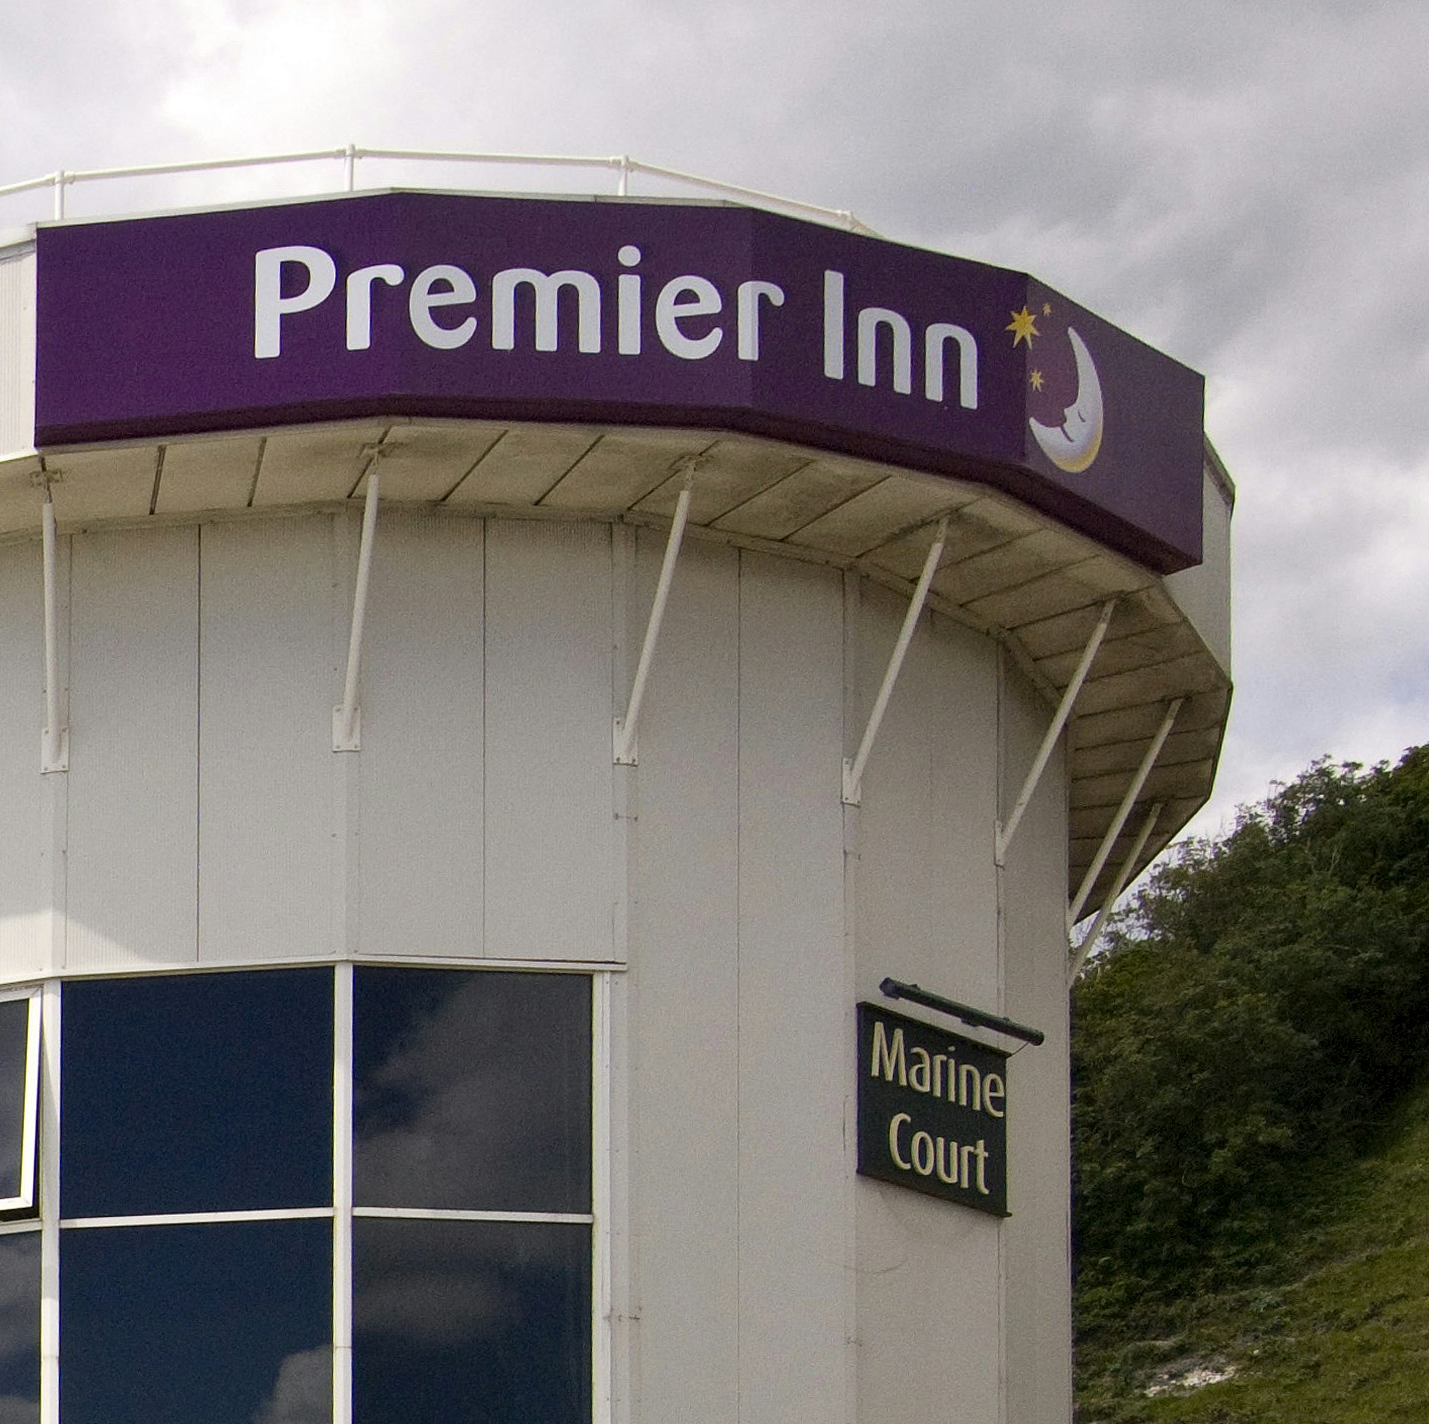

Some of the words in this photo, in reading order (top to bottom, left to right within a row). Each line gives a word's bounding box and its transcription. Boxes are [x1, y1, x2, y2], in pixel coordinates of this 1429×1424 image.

[254, 245, 785, 361] Premier
[824, 270, 978, 410] Inn
[871, 1021, 1005, 1118] Marine
[889, 1112, 990, 1195] Court
